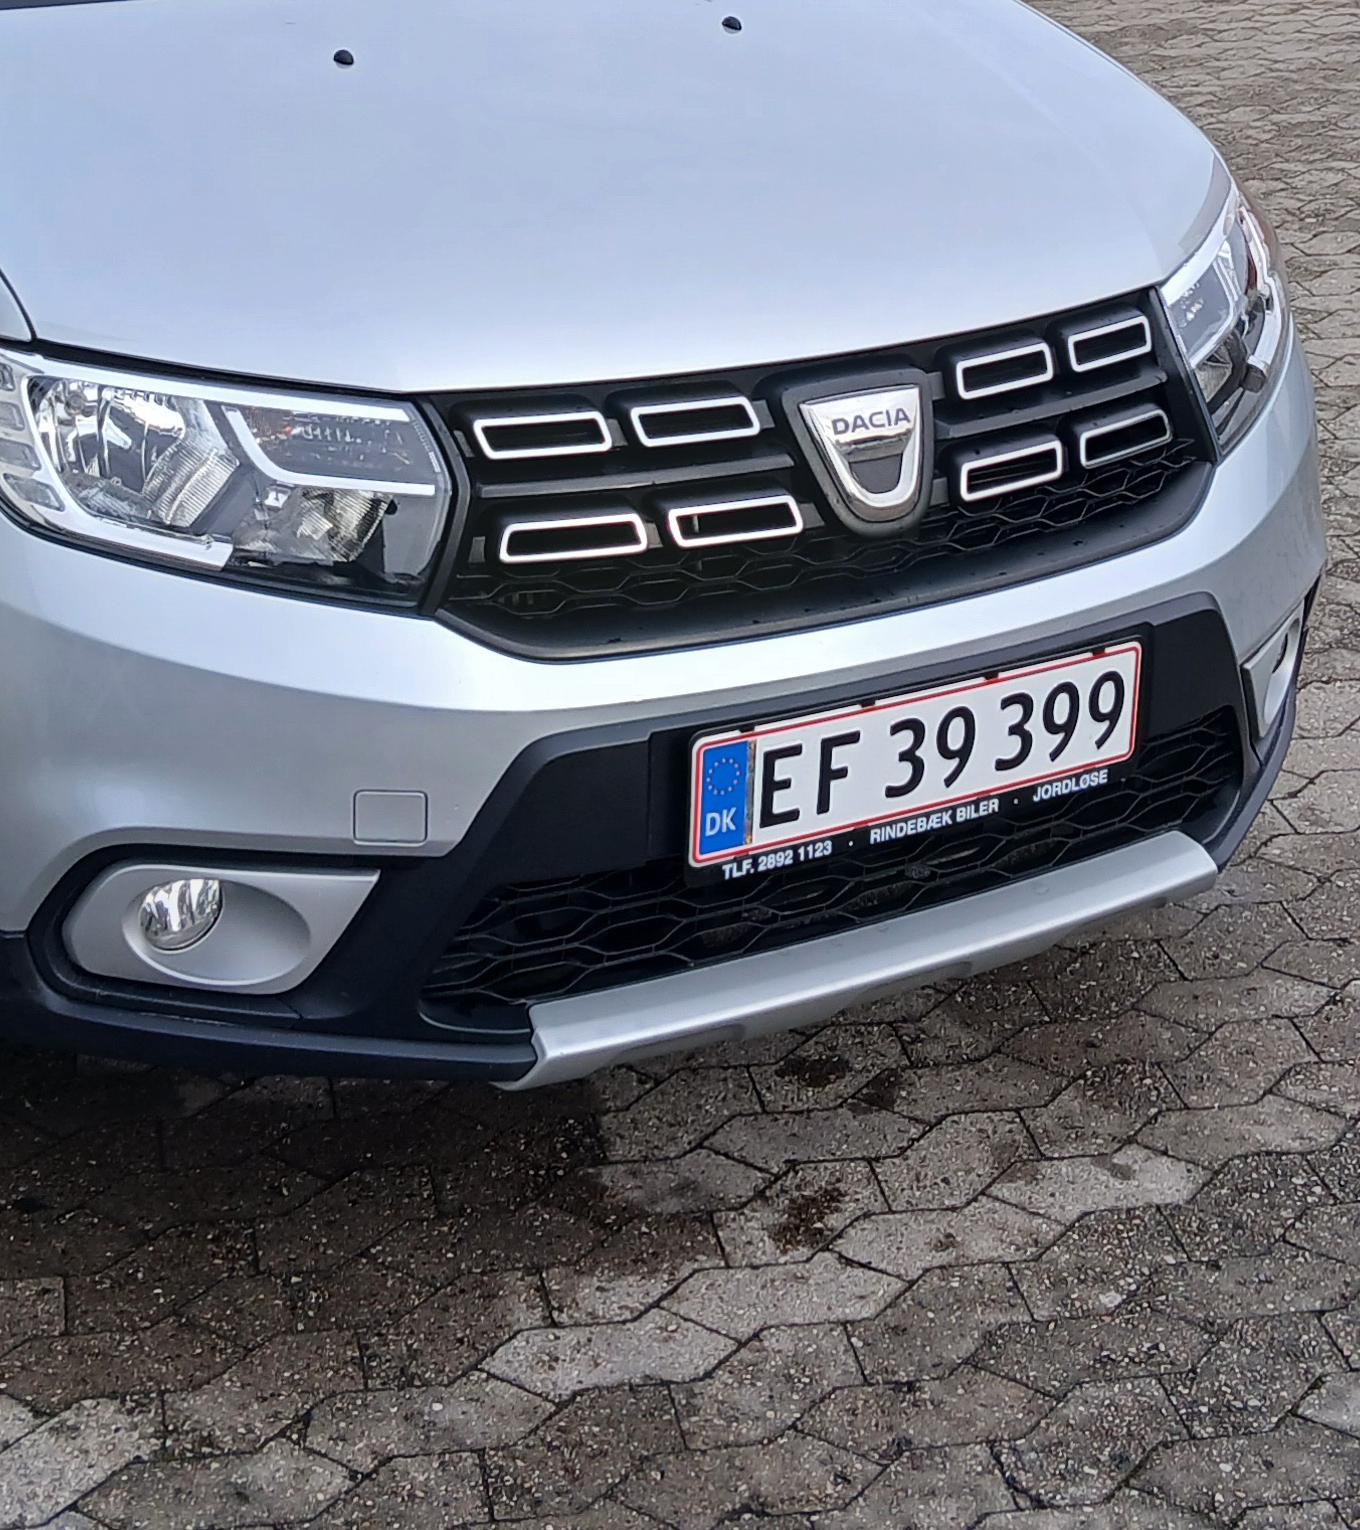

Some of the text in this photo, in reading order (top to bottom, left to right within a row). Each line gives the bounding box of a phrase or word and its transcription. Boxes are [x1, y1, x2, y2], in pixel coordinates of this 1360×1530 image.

[830, 407, 912, 436] DACIA
[759, 670, 1126, 829] EF 39 399
[705, 807, 738, 837] DK
[722, 769, 1109, 881] TLF. 2892 1123 RINDEBÆK BILER JORDLØSE
